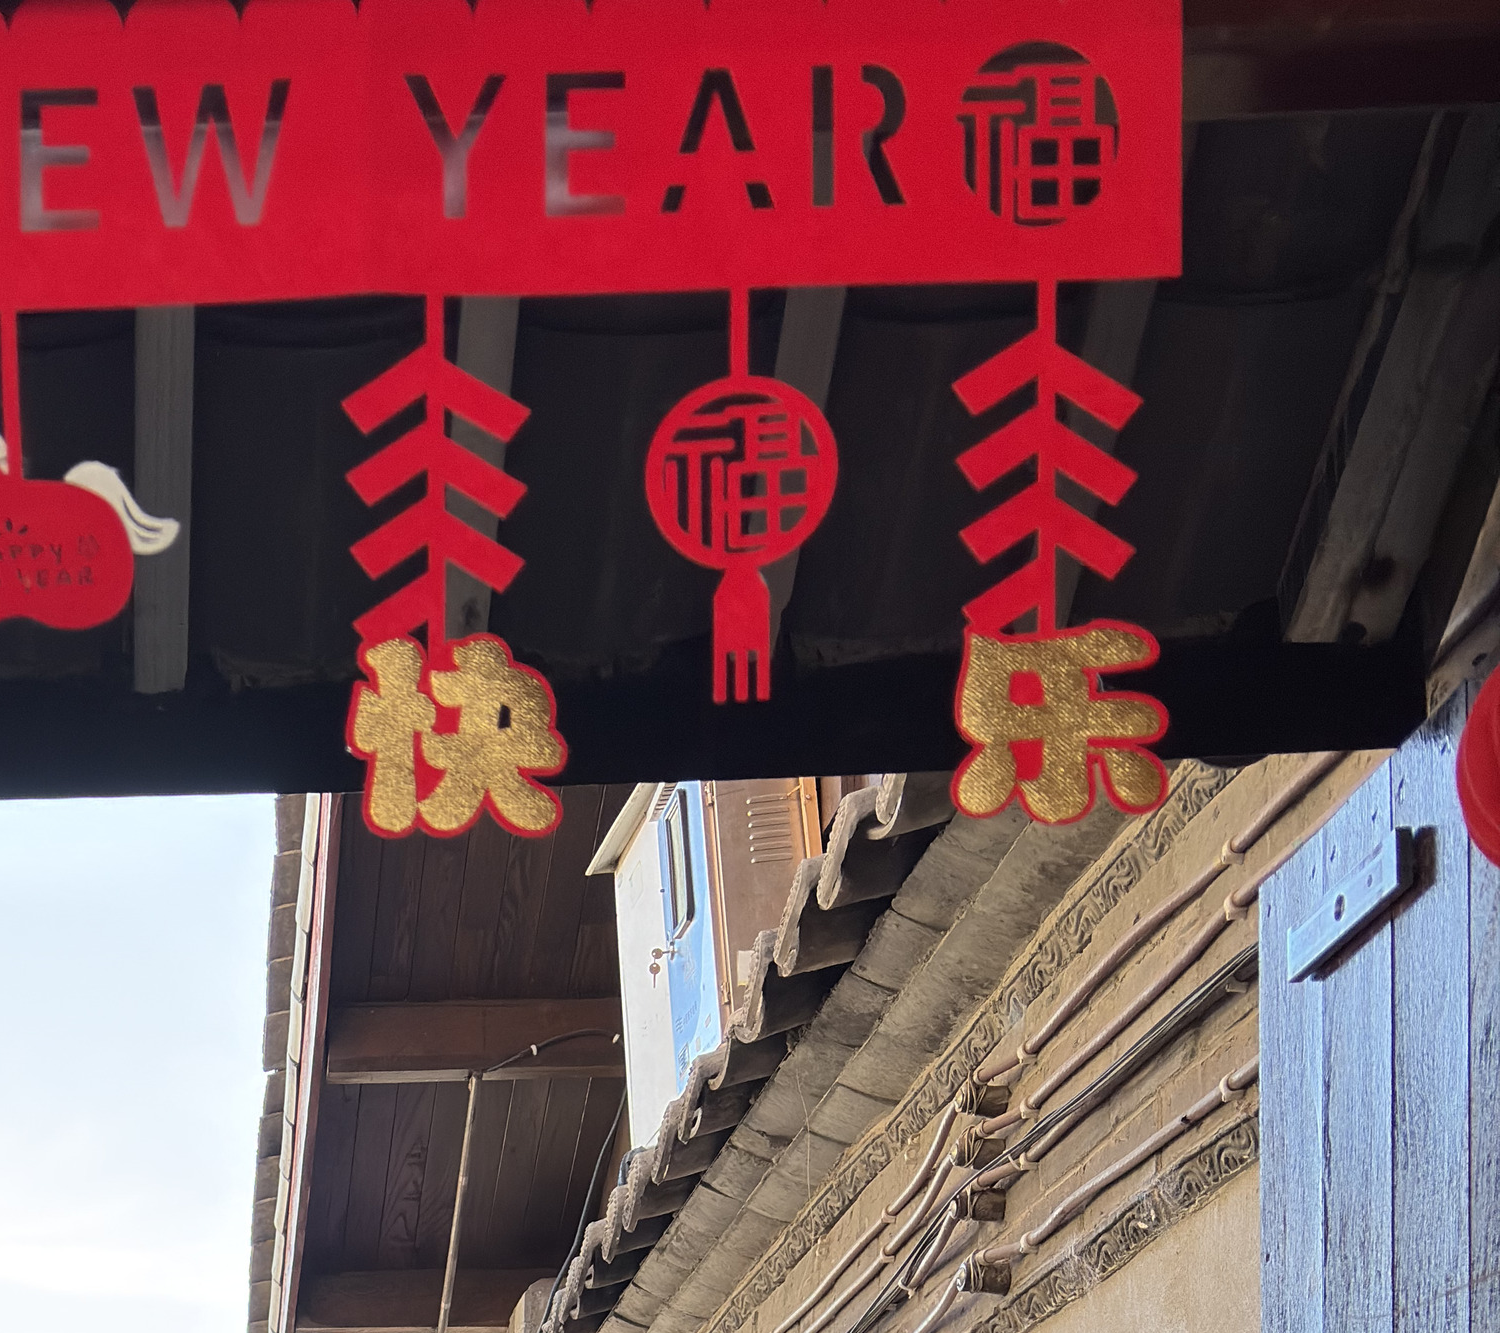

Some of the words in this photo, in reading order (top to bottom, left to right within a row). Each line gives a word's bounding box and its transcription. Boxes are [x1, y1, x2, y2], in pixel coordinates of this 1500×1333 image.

[405, 64, 906, 217] YEAR
[959, 40, 1119, 226] 福
[661, 391, 821, 556] 福
[17, 566, 93, 593] YEAR
[348, 635, 568, 837] 快
[953, 621, 1168, 822] 乐
